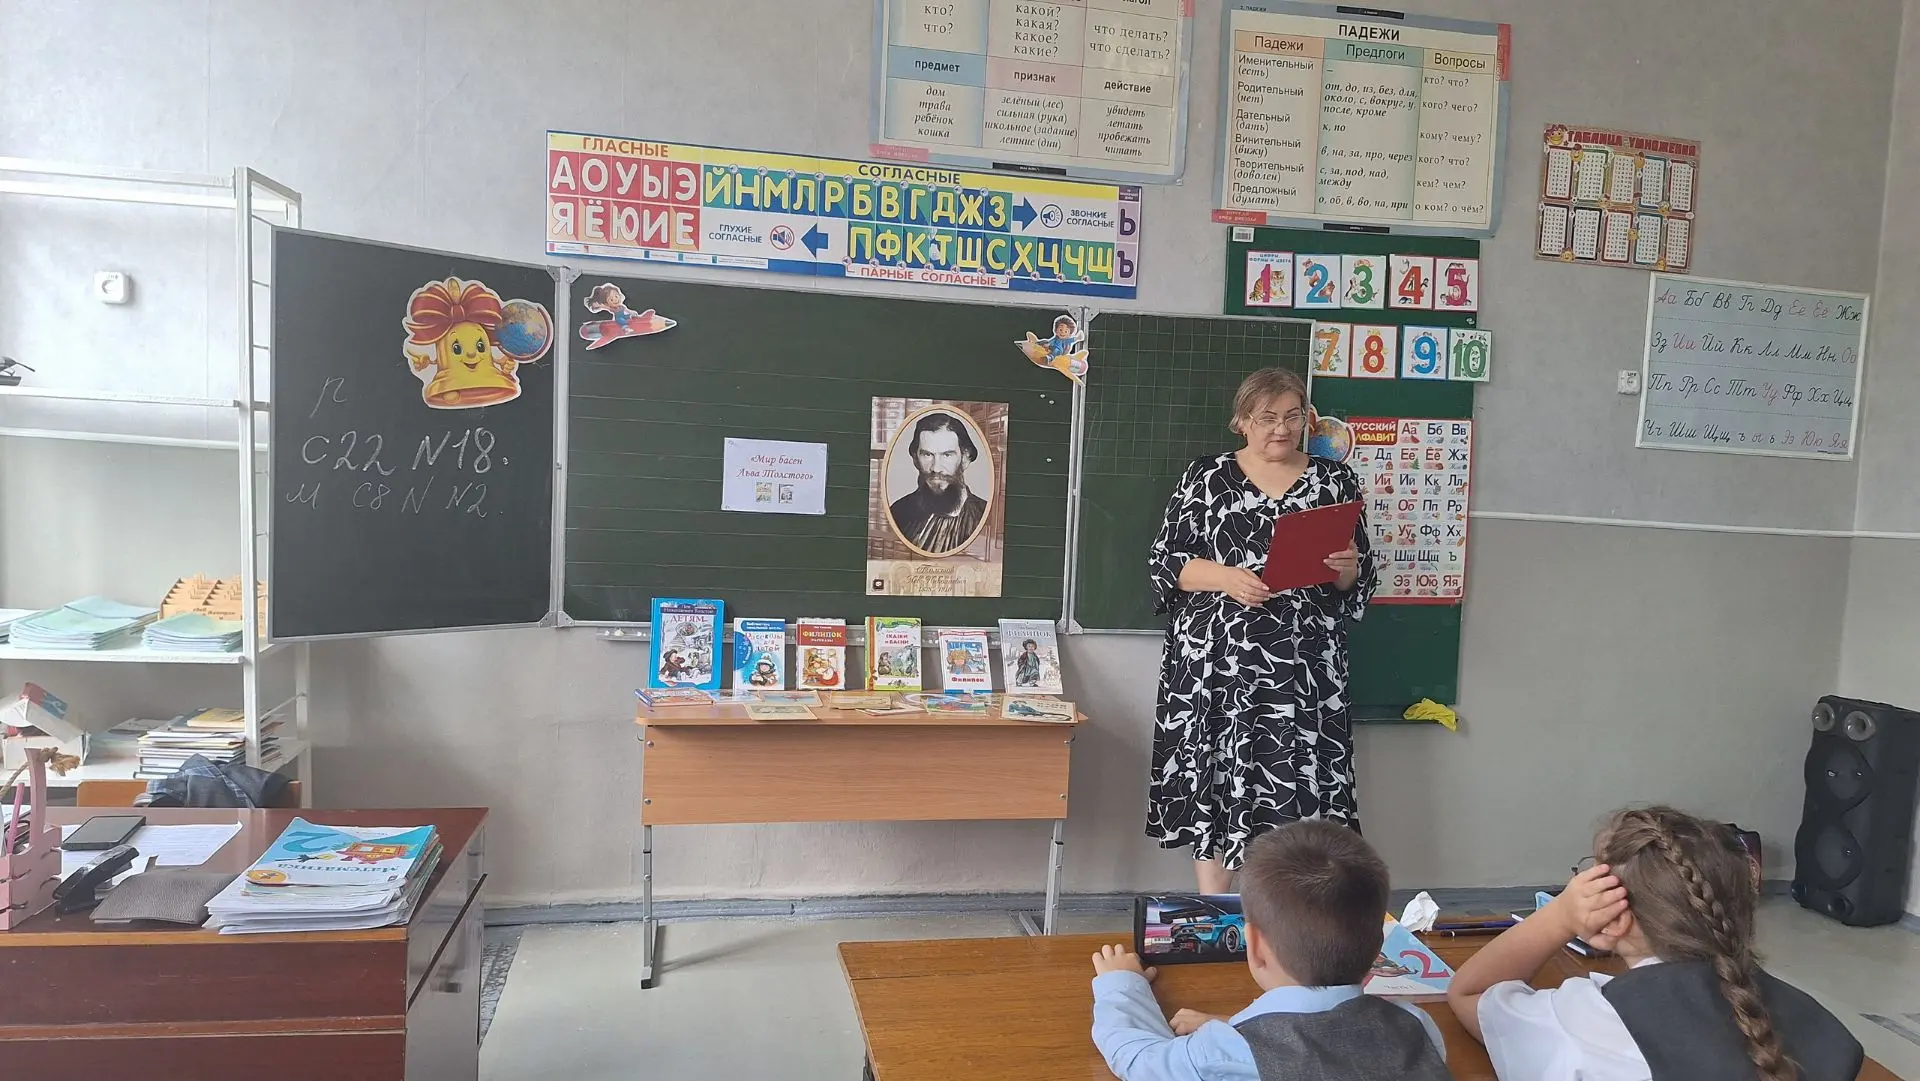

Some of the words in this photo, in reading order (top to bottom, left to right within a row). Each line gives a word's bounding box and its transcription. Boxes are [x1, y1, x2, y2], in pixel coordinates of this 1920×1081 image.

[924, 5, 954, 16] кто?
[1016, 4, 1061, 17] какой?
[924, 23, 953, 34] что?
[1016, 18, 1059, 30] какая?
[1015, 31, 1059, 44] какое?
[1094, 24, 1115, 34] что
[1120, 28, 1168, 42] делать?
[1339, 25, 1400, 41] ПАДЕЖИ
[1255, 36, 1304, 51] Падежи
[1014, 45, 1058, 57] какие?
[1089, 42, 1111, 52] что
[1116, 45, 1170, 60] сделать?
[1346, 44, 1405, 60] Предлоги
[915, 60, 960, 73] предмет
[1238, 55, 1314, 70] Именительный
[1435, 53, 1486, 69] Вопросы
[1014, 71, 1056, 83] признак
[1238, 66, 1269, 78] (есть)
[1104, 80, 1151, 93] действие
[1424, 76, 1444, 84] кто?
[1448, 79, 1468, 87] что?
[926, 85, 945, 96] дом
[1237, 82, 1304, 96] Родительный
[1001, 96, 1040, 107] зелёный
[1042, 99, 1064, 110] (лес)
[1237, 93, 1264, 106] (нет)
[920, 101, 951, 112] трава
[1107, 105, 1145, 118] увидеть
[1356, 108, 1387, 118] кроме
[1422, 101, 1448, 110] кого?
[1451, 104, 1478, 112] чего?
[915, 113, 954, 125] ребёнок
[996, 108, 1035, 119] сильная
[1038, 113, 1068, 124] (рука)
[1236, 109, 1290, 122] Дательный
[985, 121, 1031, 132] школьное
[1034, 124, 1078, 139] (задание)
[1107, 120, 1143, 131] летать
[1236, 121, 1269, 133] (дать)
[918, 128, 950, 138] кошка
[1098, 132, 1151, 145] пробежать
[1420, 132, 1448, 143] кому?
[1452, 134, 1481, 145] чему?
[583, 137, 669, 158] ГЛАСНЫЕ
[1000, 137, 1035, 147] летние
[1038, 138, 1061, 150] (дни)
[1235, 134, 1301, 148] Винительный
[1105, 146, 1142, 156] читать
[1235, 145, 1268, 157] (вижу)
[1388, 152, 1412, 163] через
[1234, 158, 1304, 173] Творительный
[1418, 156, 1444, 165] кого?
[1448, 158, 1469, 166] что?
[858, 164, 961, 185] СОГЛАСНЫЕ
[1233, 170, 1281, 183] (доволен)
[1233, 183, 1296, 196] Предложный
[1319, 178, 1351, 189] между
[1417, 179, 1439, 188] кем?
[1443, 181, 1465, 189] чем?
[1232, 194, 1279, 206] (думать)
[1424, 203, 1448, 211] ком?
[1070, 209, 1107, 219] ЗВОНКИЕ
[719, 223, 752, 234] ГЛУХИЕ
[1066, 217, 1115, 229] СОГЛАСНЫЕ
[709, 232, 762, 244] СОГЛАСНЫЕ
[861, 267, 913, 281] ПАРНЫЕ
[921, 272, 996, 287] СОГЛАСНЫЕ
[1261, 264, 1271, 303] 1
[1305, 264, 1328, 303] 2
[1351, 265, 1373, 304] 3
[1398, 266, 1424, 304] 4
[1446, 268, 1467, 306] 5
[1654, 288, 1677, 305] Аа
[1316, 332, 1340, 371] 7
[1363, 335, 1384, 373] 8
[1414, 336, 1437, 375] 9
[1453, 339, 1486, 378] 10
[1350, 421, 1396, 431] РУССКИЙ
[1401, 423, 1417, 435] Аа
[1427, 424, 1443, 435] Бб
[1451, 424, 1466, 436] Вв
[1355, 433, 1396, 442] ЛФАВИТ
[751, 454, 776, 466] «Мир
[779, 454, 803, 465] басен
[736, 468, 760, 478] Льва
[762, 469, 813, 480] Толстого»
[803, 631, 842, 639] ФИЛИПОК
[283, 831, 341, 852] 2
[1399, 950, 1450, 978] 2
